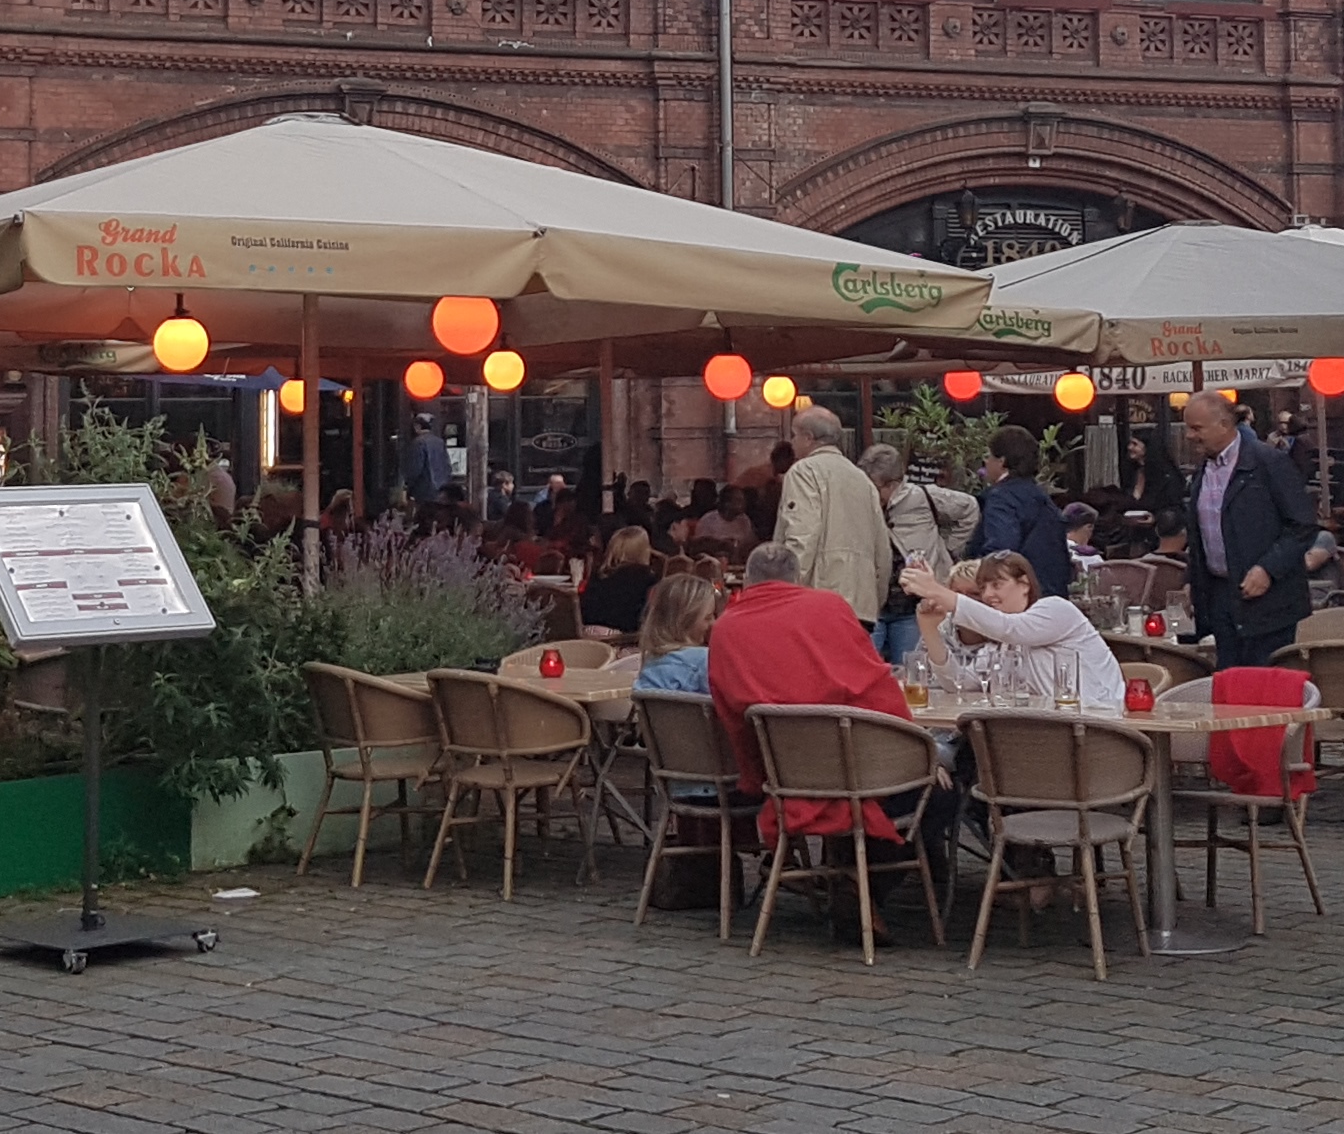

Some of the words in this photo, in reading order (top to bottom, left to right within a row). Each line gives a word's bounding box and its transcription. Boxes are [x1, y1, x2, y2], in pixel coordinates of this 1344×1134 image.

[98, 217, 178, 247] Grand
[230, 235, 268, 249] Original
[270, 237, 314, 250] California
[316, 238, 350, 251] Cuisine
[832, 261, 943, 308] Carlsberg
[1162, 320, 1203, 338] Grand
